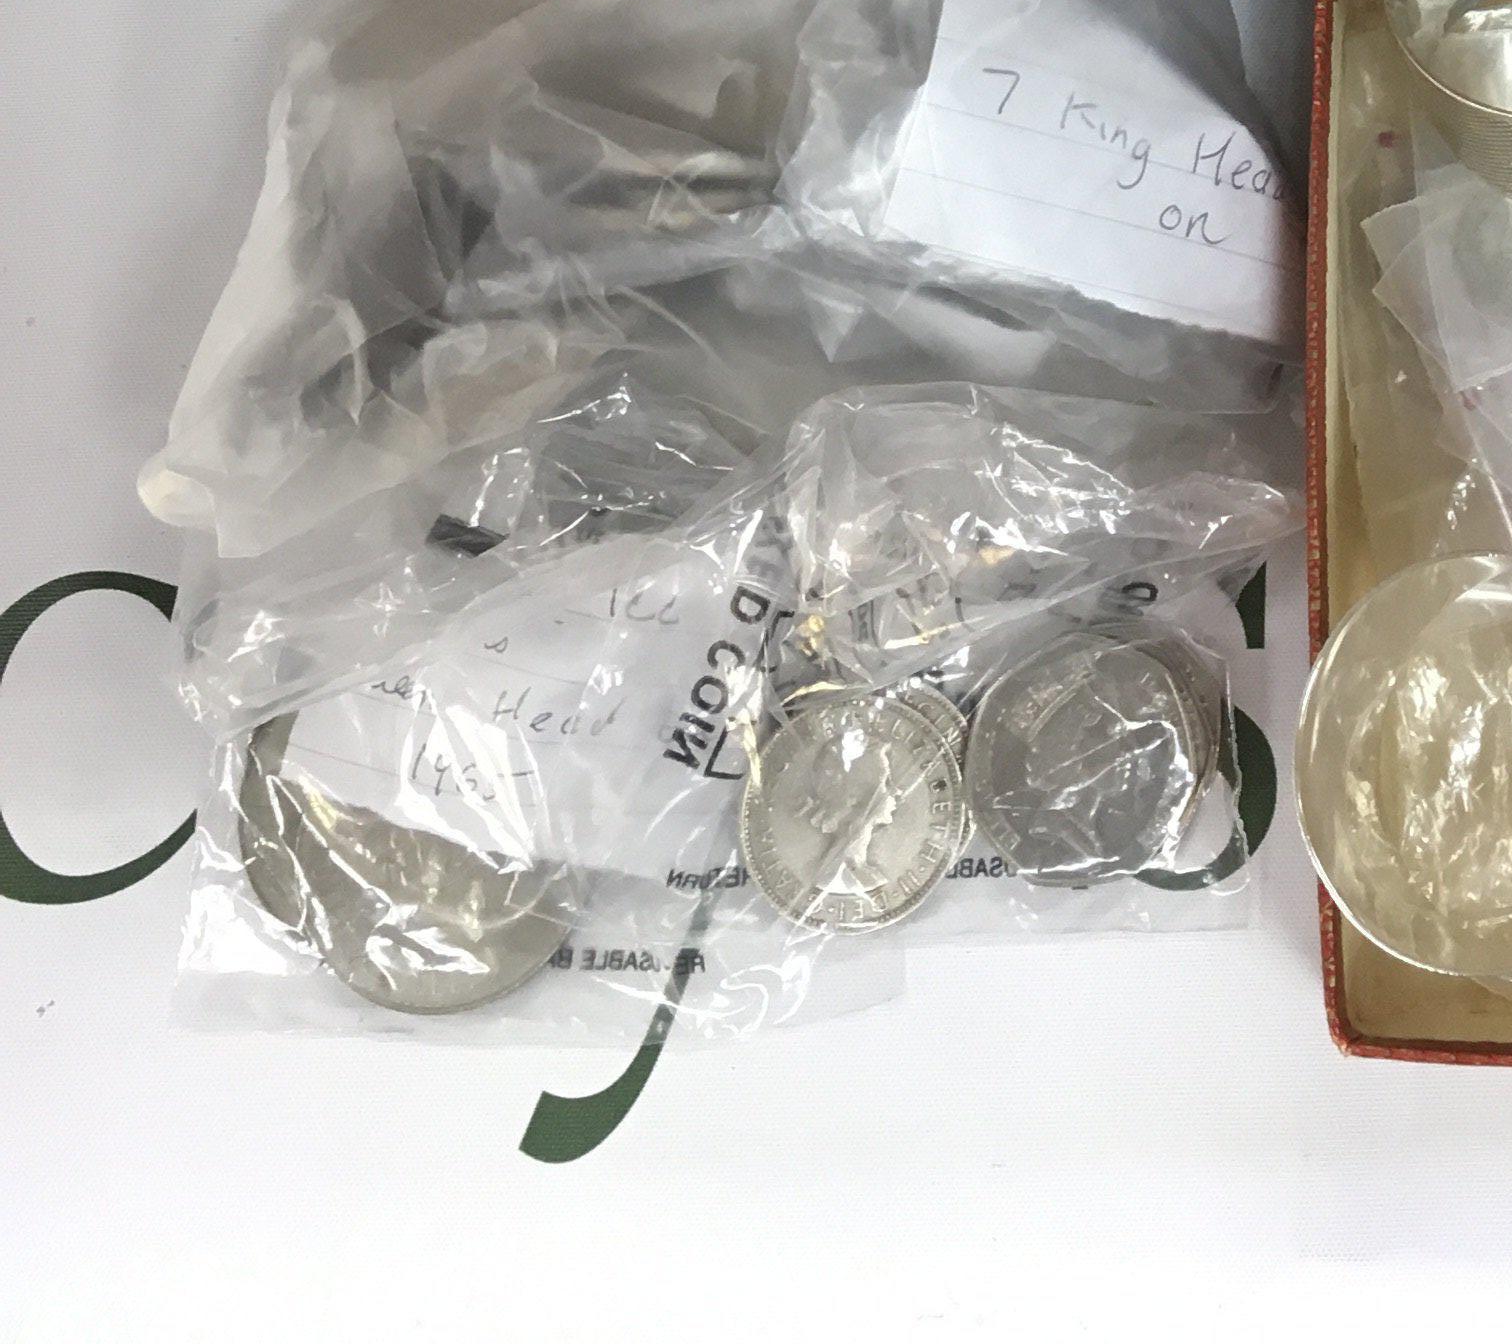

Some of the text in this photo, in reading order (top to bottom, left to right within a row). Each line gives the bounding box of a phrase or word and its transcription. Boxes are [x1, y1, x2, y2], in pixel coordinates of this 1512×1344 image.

[982, 67, 1021, 115] 7
[1059, 93, 1154, 190] King
[492, 685, 627, 737] Head
